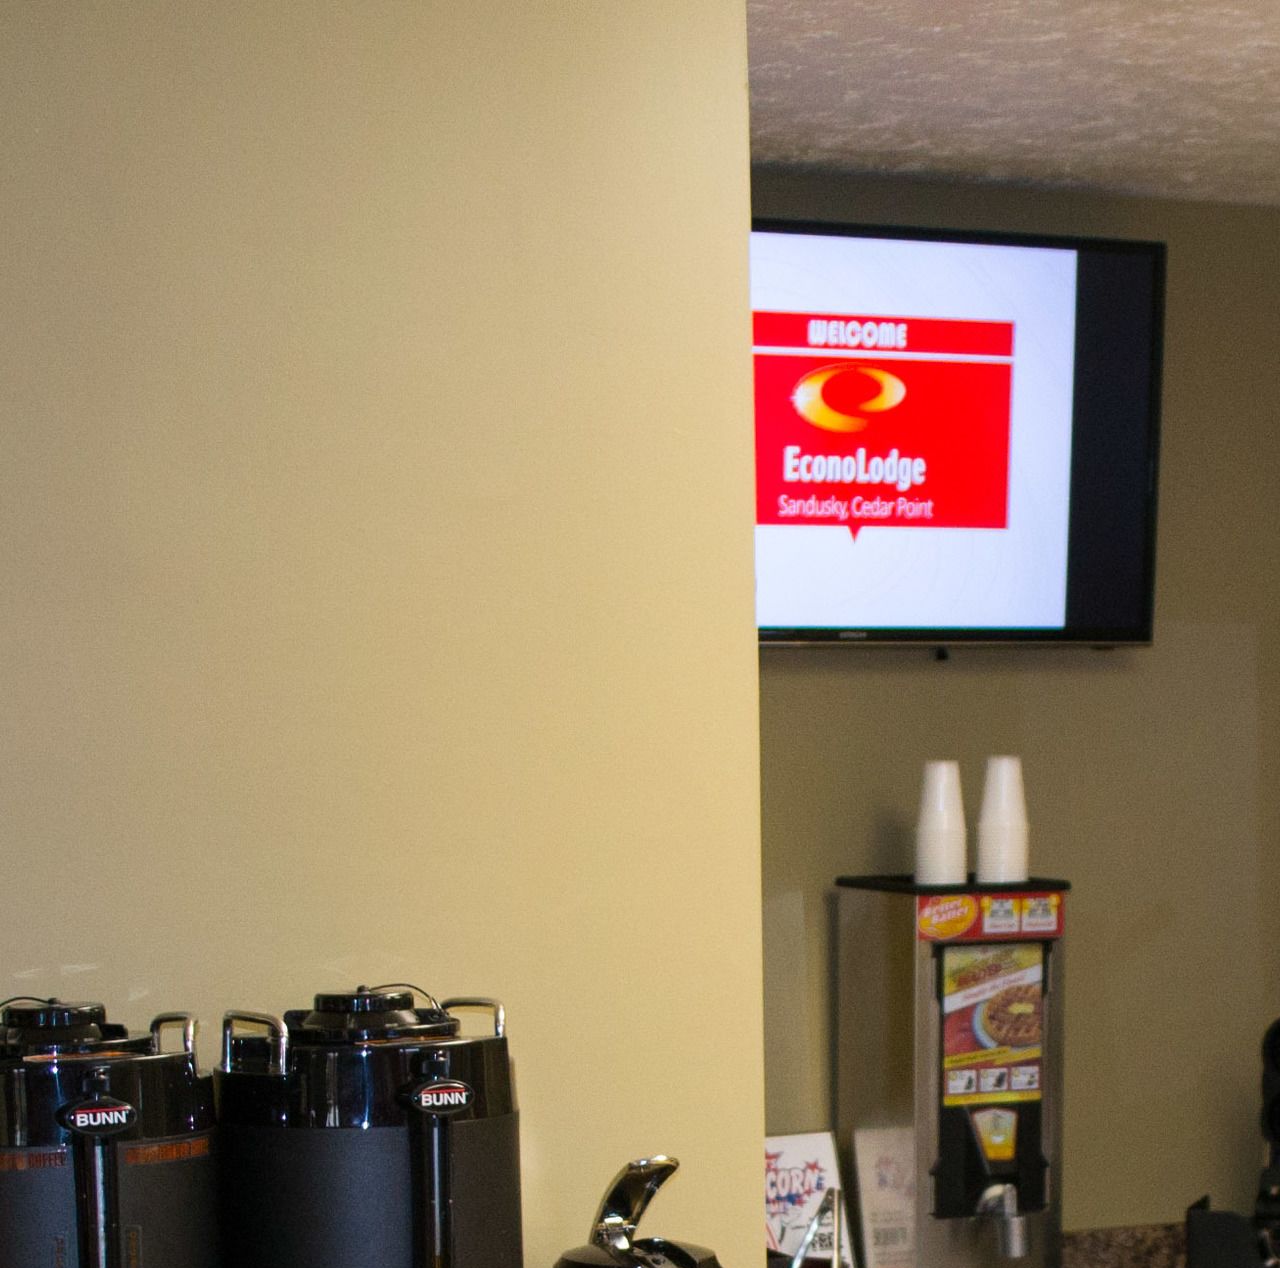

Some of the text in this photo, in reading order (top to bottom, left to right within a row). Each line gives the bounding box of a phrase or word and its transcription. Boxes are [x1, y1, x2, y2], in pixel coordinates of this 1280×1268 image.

[807, 318, 908, 349] WELCOME
[783, 445, 927, 491] EconoLodge
[777, 494, 934, 521] Sandusky, Cedar Point
[421, 1091, 467, 1108] BUNN
[76, 1109, 128, 1128] BUNN
